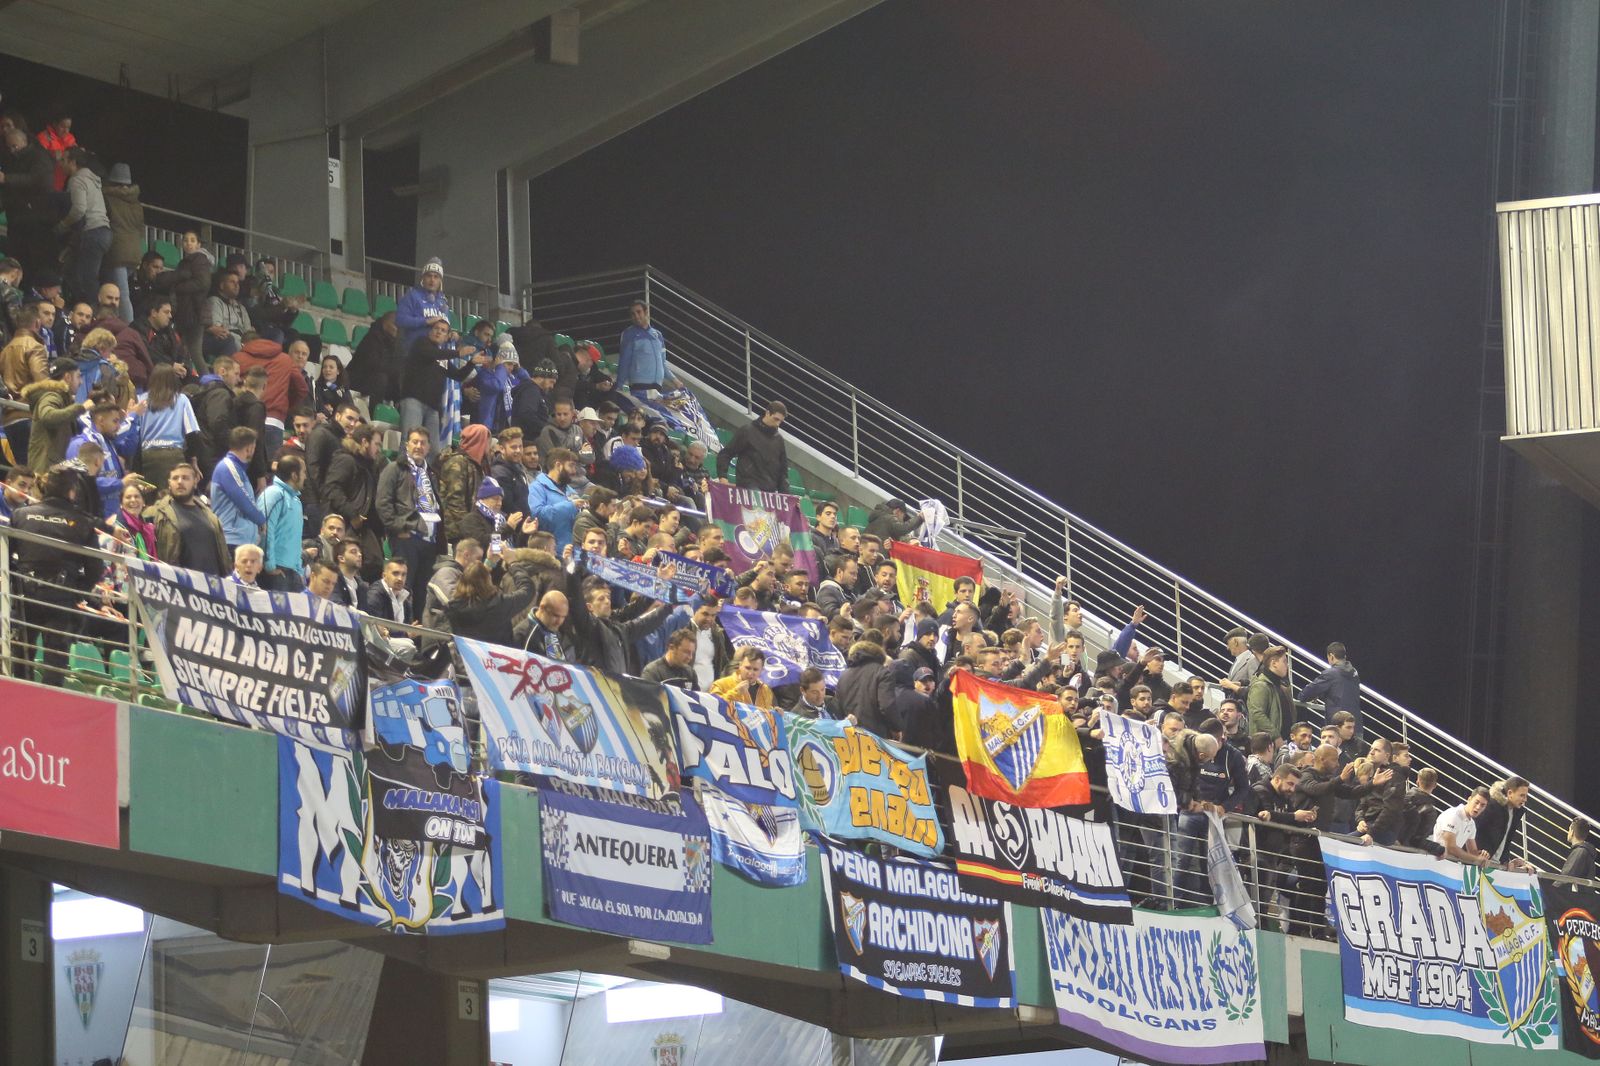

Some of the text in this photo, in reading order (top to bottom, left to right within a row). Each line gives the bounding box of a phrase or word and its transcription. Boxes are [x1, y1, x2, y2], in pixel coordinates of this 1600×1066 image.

[133, 575, 358, 654] PEÑA ORGULLO MALAGUISTA
[174, 616, 291, 675] MALAGA
[293, 648, 329, 685] C.F.
[172, 653, 332, 725] SIEMPRE FIELES
[987, 723, 1019, 751] MALAGA
[425, 815, 454, 840] ON
[573, 832, 679, 870] ANTEQUERA
[829, 846, 882, 888] PEÑA
[616, 902, 633, 917] SOL
[634, 905, 652, 920] POR
[868, 902, 975, 960] ARCHIDONA
[1330, 871, 1499, 971] GRADA
[29, 938, 37, 957] 3
[465, 998, 473, 1015] 3
[1054, 977, 1218, 1032] HOOLIGANS
[1361, 951, 1474, 1014] MCF 1904
